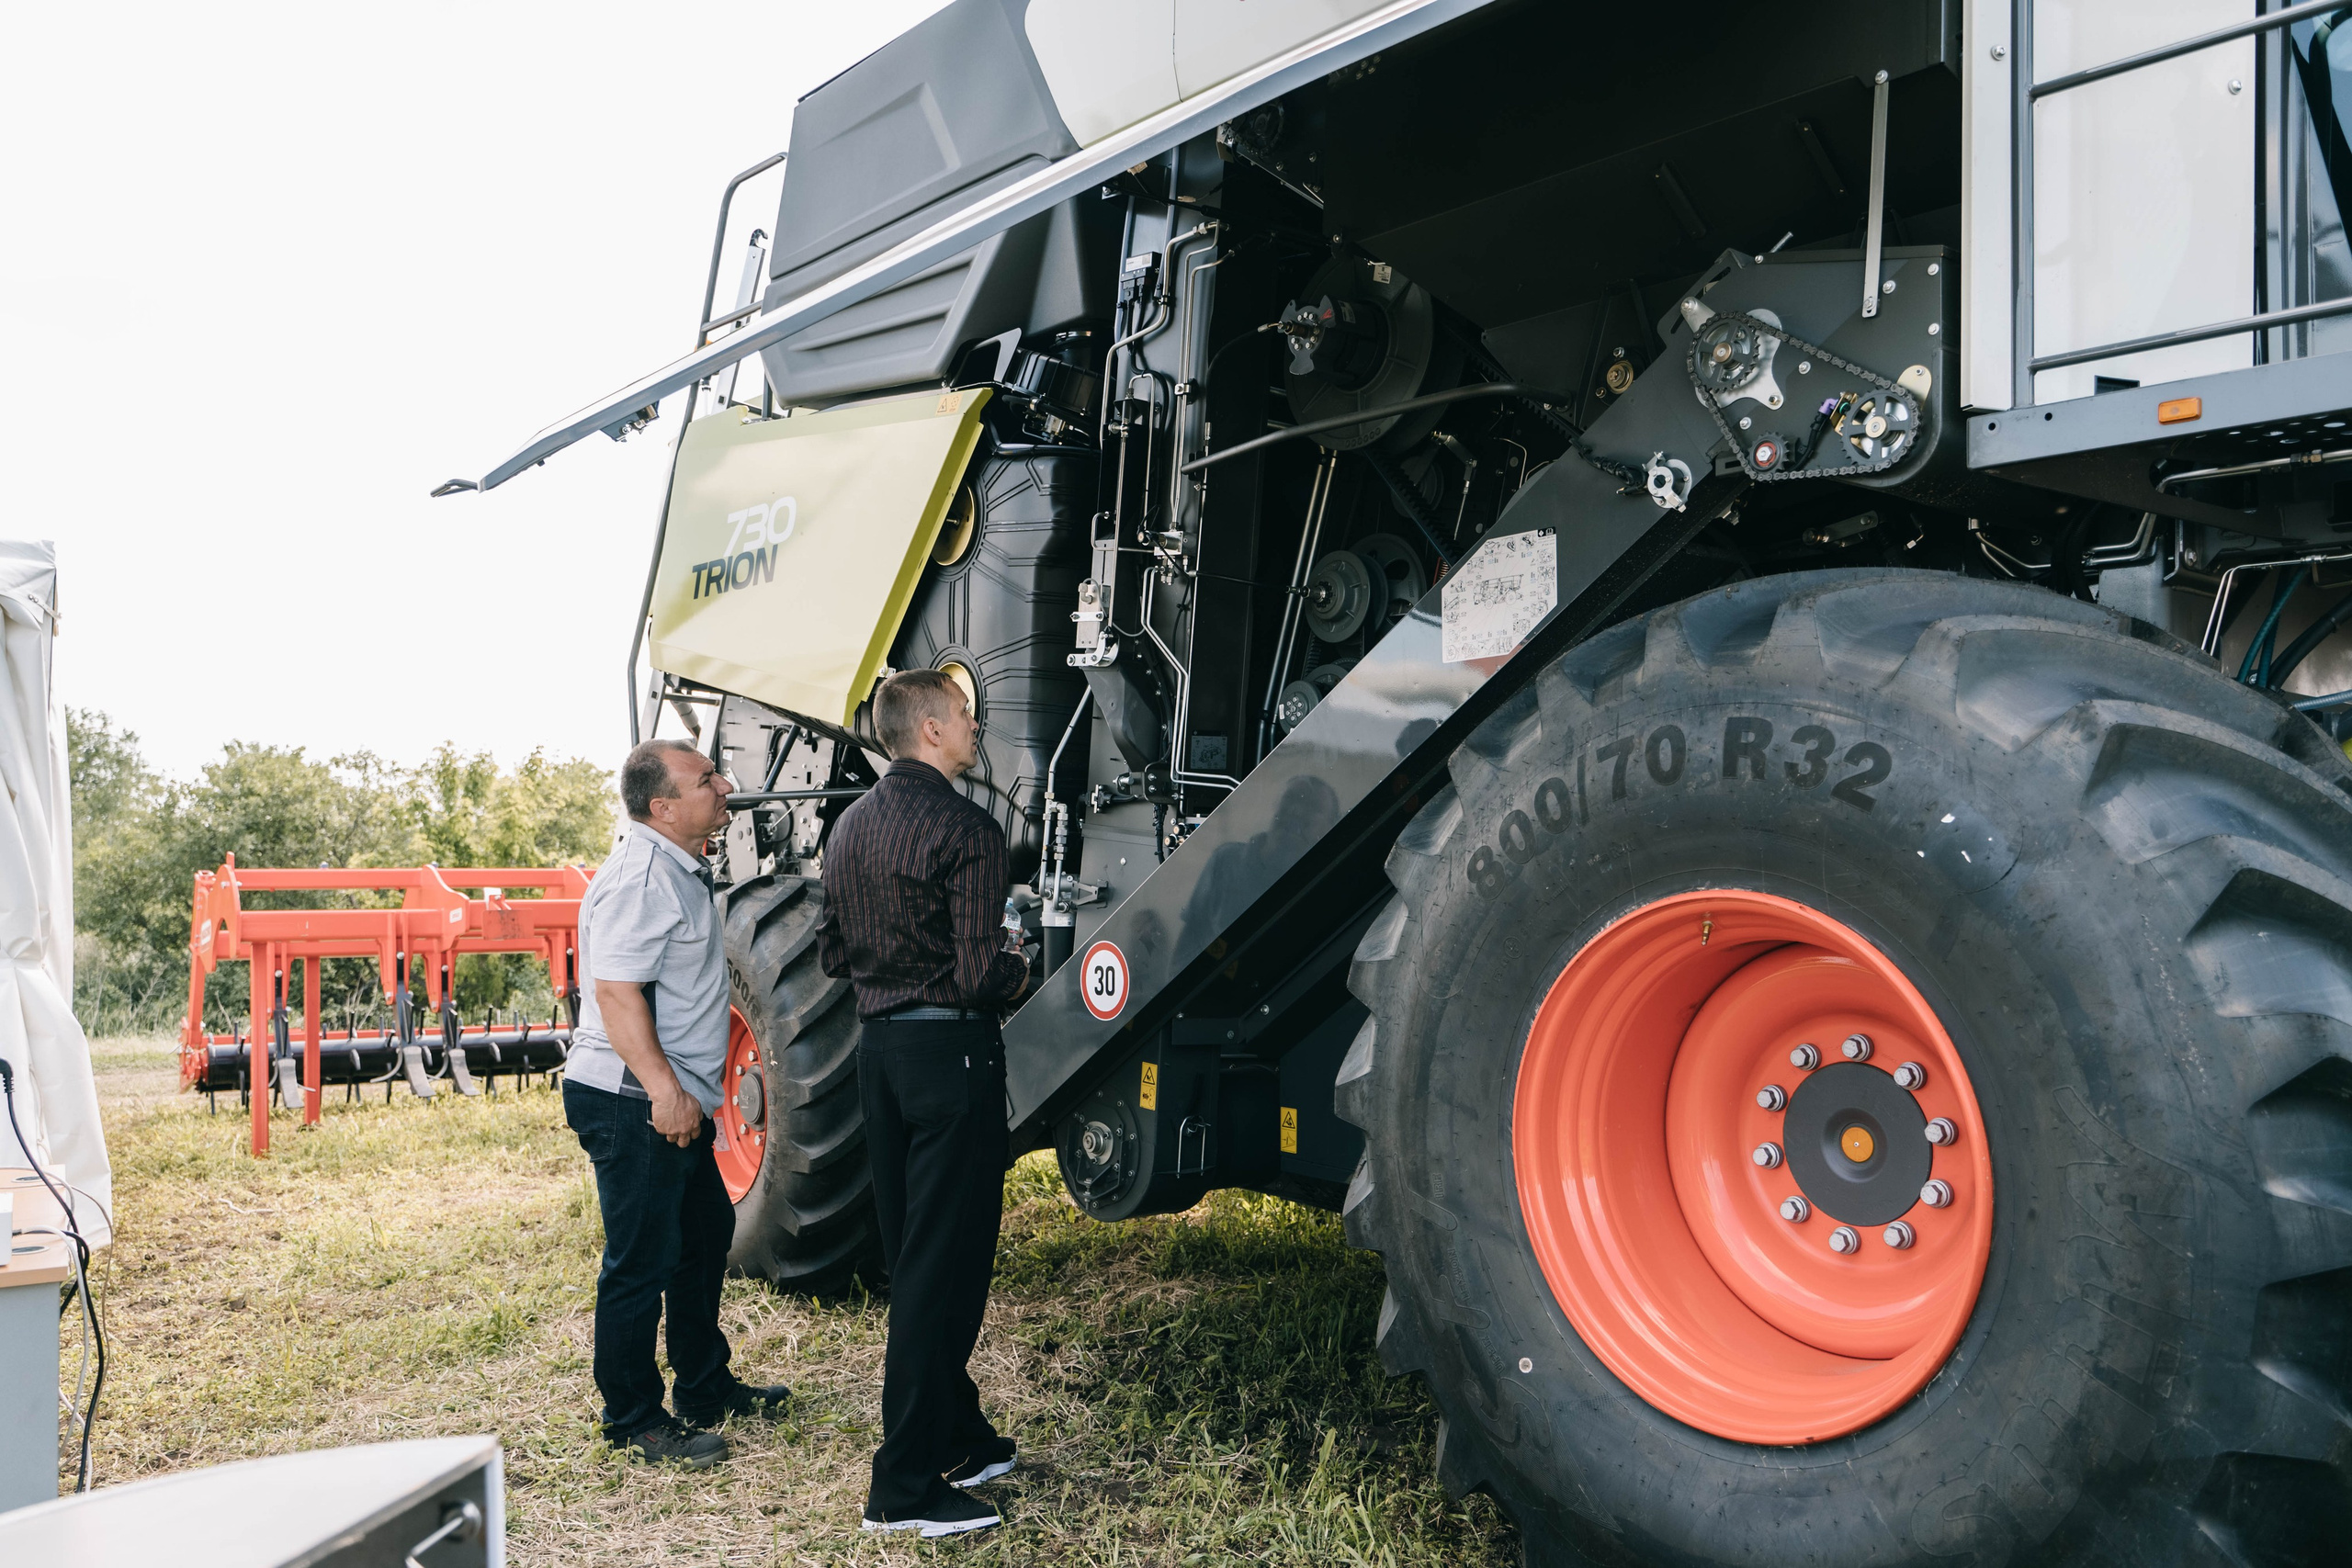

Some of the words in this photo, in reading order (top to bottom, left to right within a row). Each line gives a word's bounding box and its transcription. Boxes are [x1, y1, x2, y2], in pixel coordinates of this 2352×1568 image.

[723, 496, 797, 558] 730
[692, 544, 778, 600] TRION
[1466, 725, 1687, 901] 800/70
[1094, 965, 1115, 997] 30
